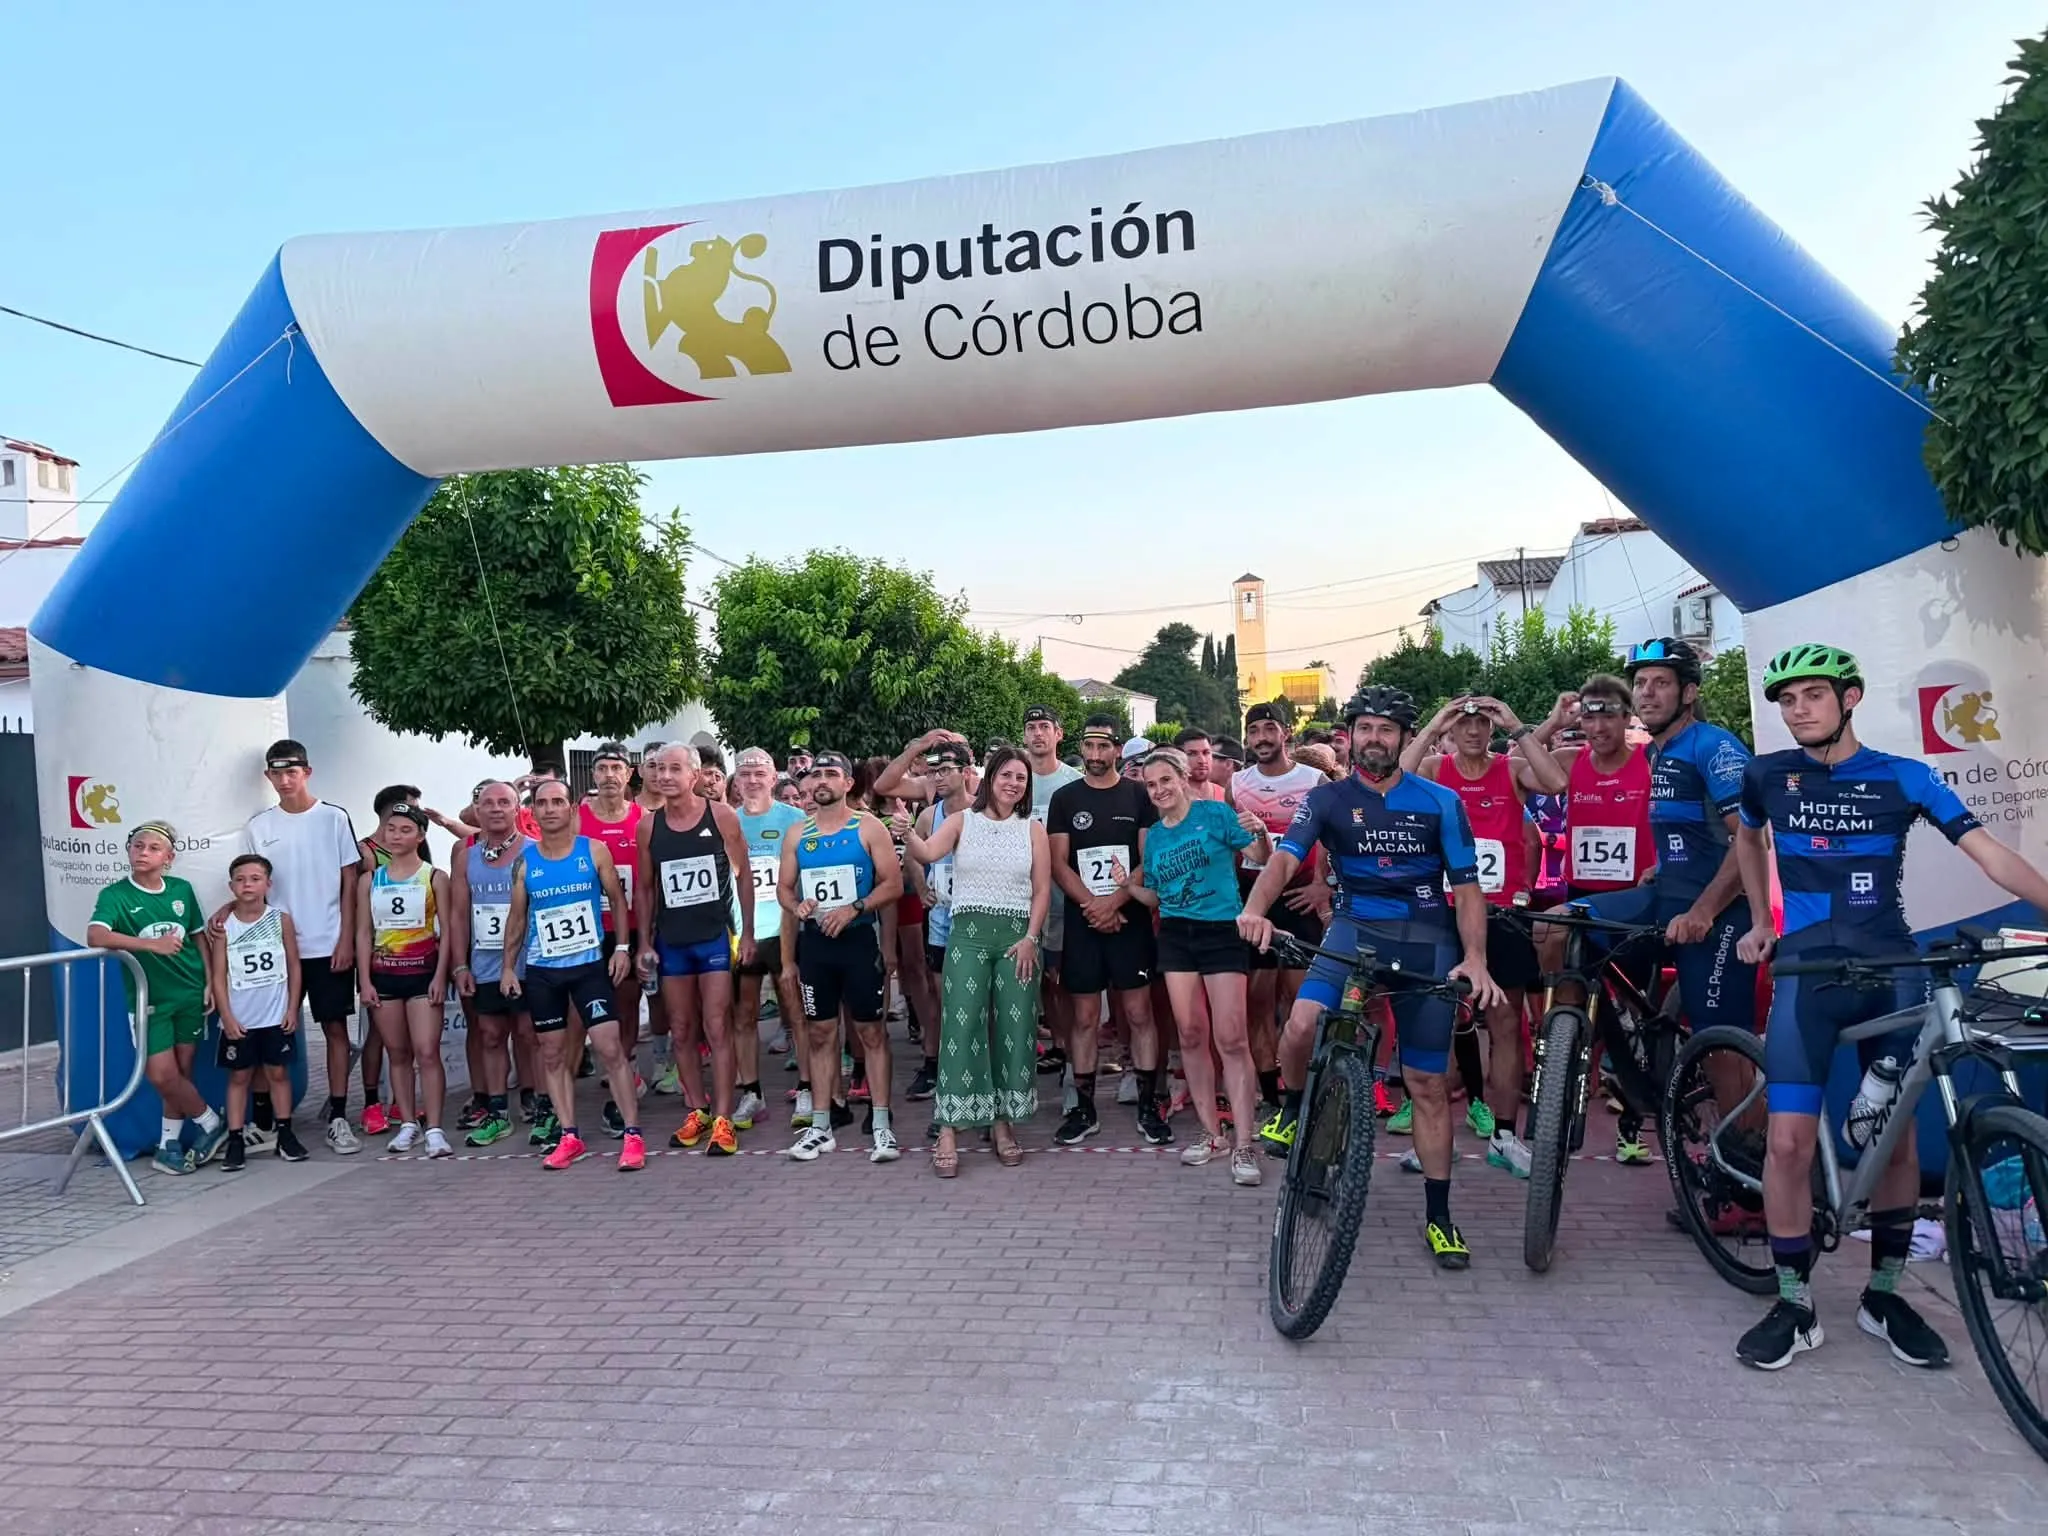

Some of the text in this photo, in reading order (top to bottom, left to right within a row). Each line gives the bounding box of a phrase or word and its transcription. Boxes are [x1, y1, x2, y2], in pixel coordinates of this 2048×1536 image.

[818, 201, 1196, 300] Diputación
[822, 282, 1204, 371] de Córdoba
[1966, 762, 1998, 784] de
[1966, 785, 2048, 807] de Deporte
[1788, 814, 1873, 831] MACAMI
[2003, 806, 2034, 821] Civil
[95, 840, 118, 855] de
[1357, 841, 1427, 854] MACAMI
[1578, 840, 1628, 864] 154
[668, 868, 713, 893] 170
[814, 879, 844, 902] 61
[391, 896, 406, 915] 8
[544, 914, 591, 943] 131
[242, 951, 274, 974] 58
[1708, 924, 1736, 985] Perabeña
[1665, 1112, 1679, 1179] HUTCHINSON
